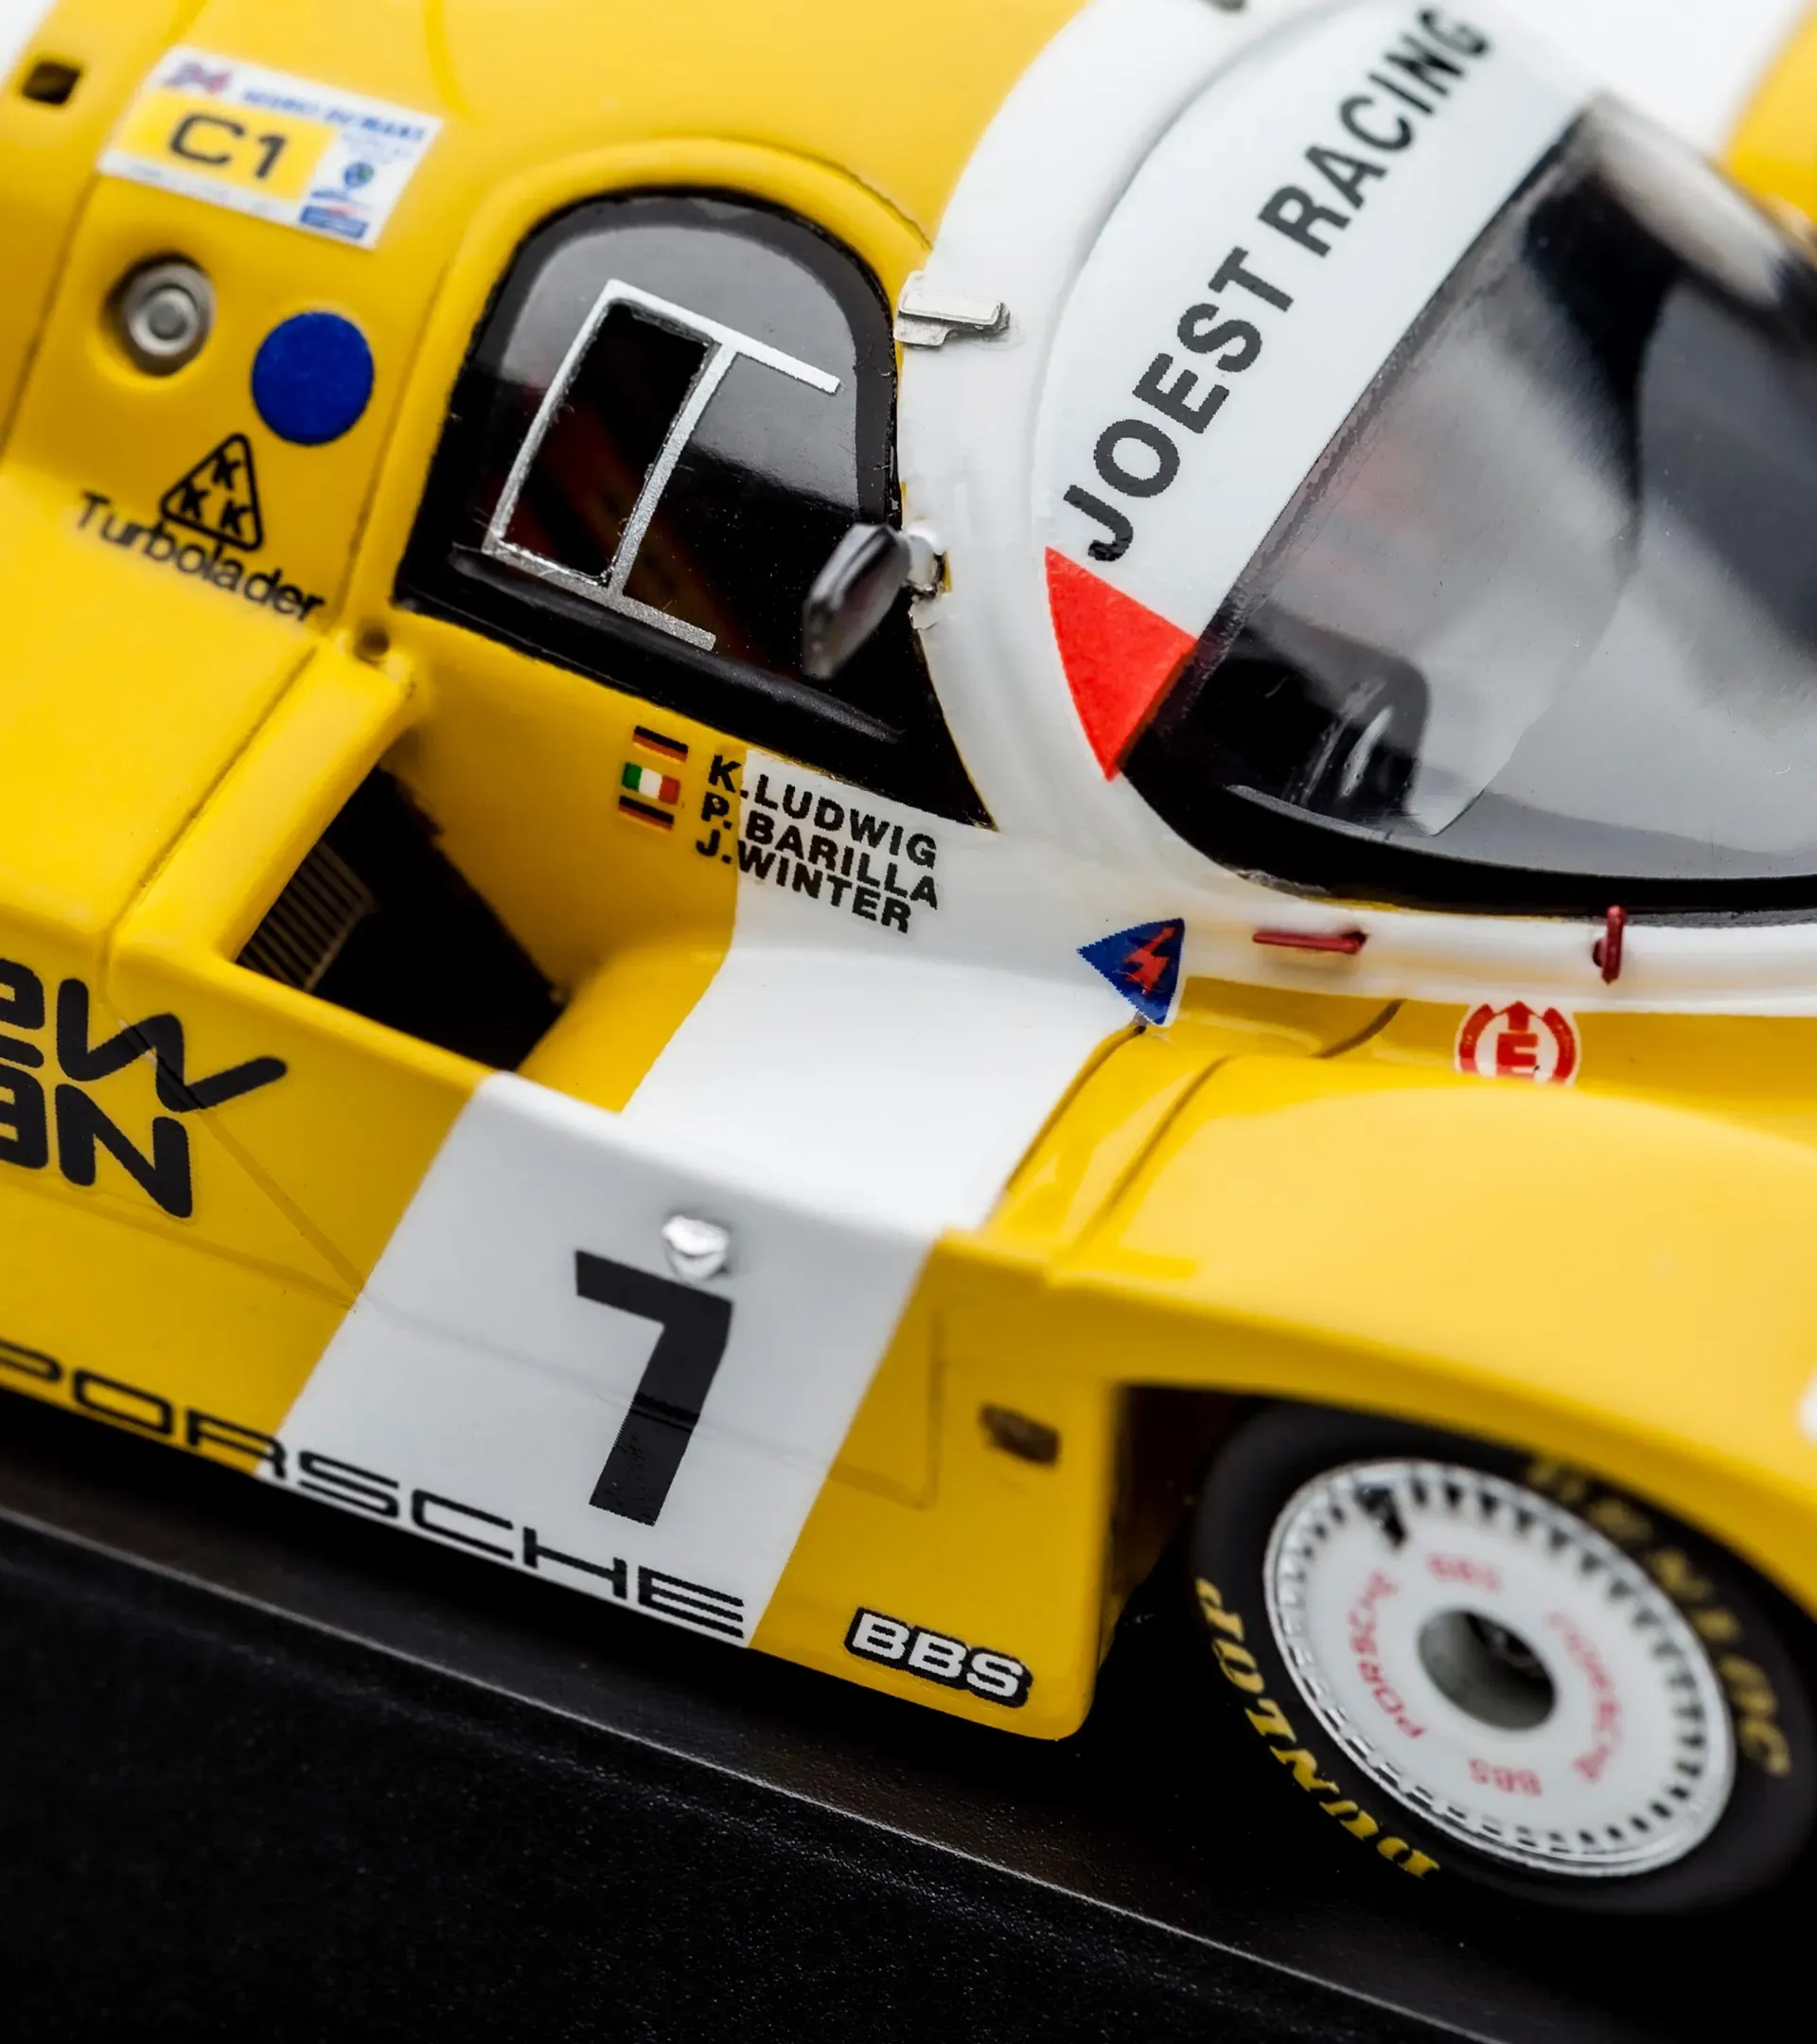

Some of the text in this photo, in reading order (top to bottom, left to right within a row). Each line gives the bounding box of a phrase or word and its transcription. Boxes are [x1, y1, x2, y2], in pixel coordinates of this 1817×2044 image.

[168, 111, 289, 181] C1
[1064, 7, 1492, 562] JOEST RACING
[79, 490, 326, 622] Turbolader
[0, 1336, 746, 1641] PORSCHE
[574, 1248, 732, 1527] 7
[849, 1610, 1029, 1704] BBS
[1195, 1577, 1440, 1879] DUNLOP
